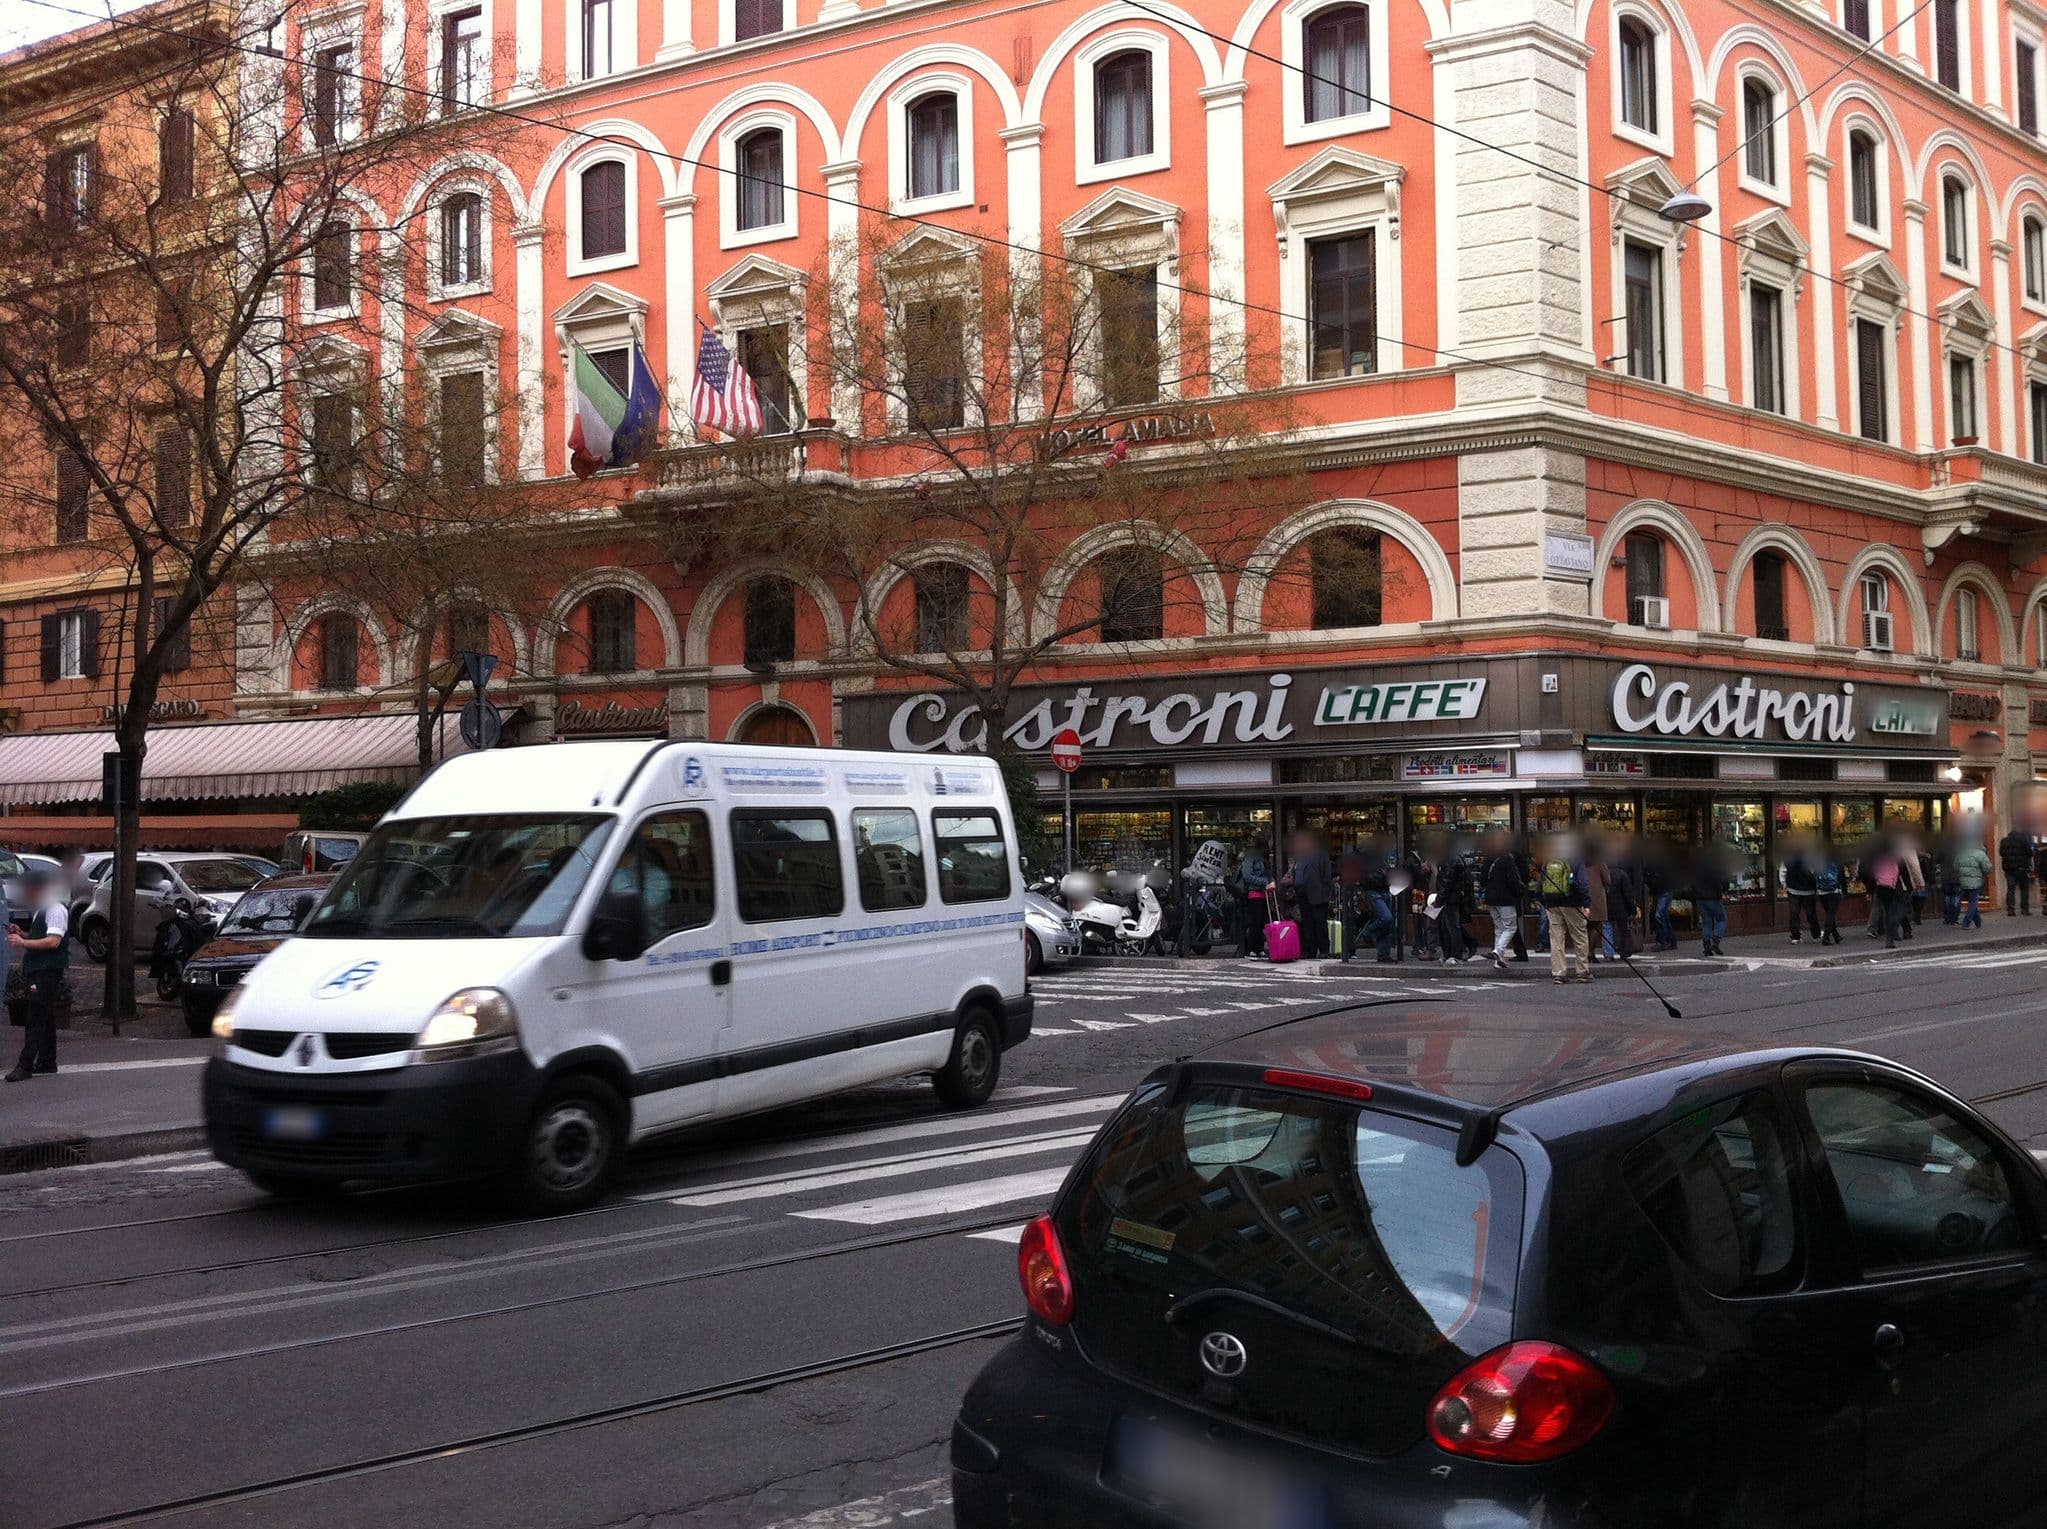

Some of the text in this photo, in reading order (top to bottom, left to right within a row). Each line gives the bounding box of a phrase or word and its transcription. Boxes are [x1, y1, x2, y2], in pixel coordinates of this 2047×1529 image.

[888, 673, 1296, 752] Castroni
[1612, 663, 1857, 742] Castroni
[1203, 843, 1225, 860] RENT
